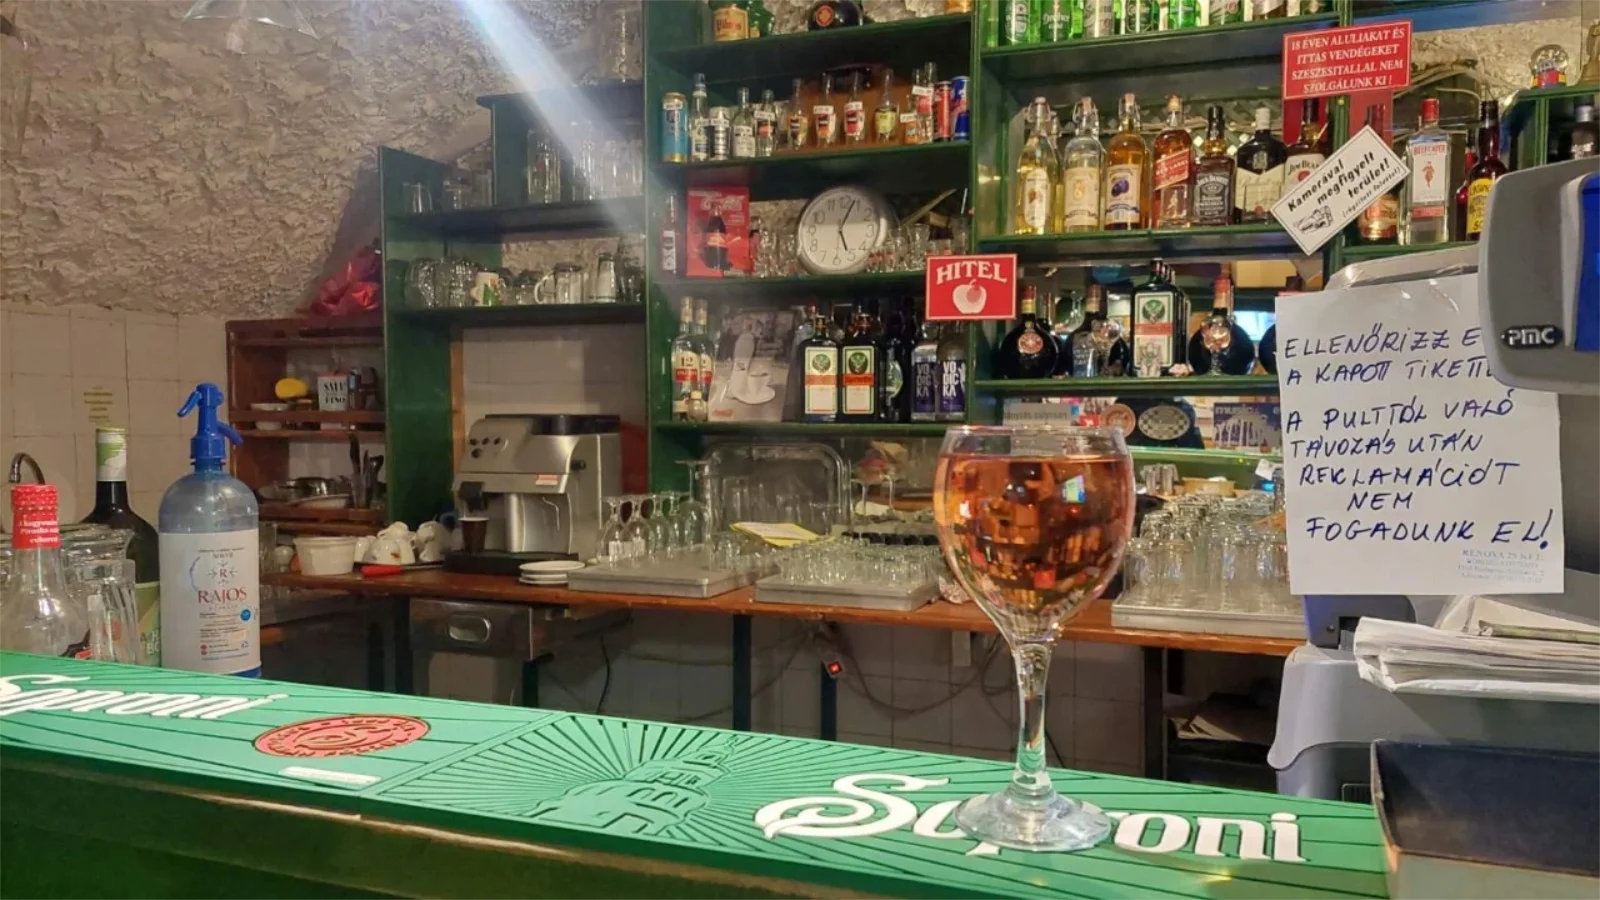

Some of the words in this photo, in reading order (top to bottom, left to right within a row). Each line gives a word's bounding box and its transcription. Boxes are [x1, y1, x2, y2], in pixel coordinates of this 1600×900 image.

[1291, 40, 1301, 51] 18
[1302, 36, 1329, 50] ÉVEN
[1392, 27, 1405, 39] ÉS
[1297, 51, 1327, 65] ITTAS
[1329, 43, 1400, 60] VENDÉGEKET
[1379, 59, 1404, 71] NEM
[1303, 77, 1373, 94] SZOLGÁLUNK
[1286, 158, 1345, 212] Kamerával
[1317, 151, 1375, 205] megfigyelt
[1347, 157, 1390, 198] terület!
[936, 260, 1008, 286] HITEL
[1286, 367, 1302, 386] A
[1315, 359, 1394, 385] KAPOTT
[1286, 410, 1303, 432] A
[1445, 388, 1515, 419] VALÓ
[1290, 428, 1397, 459] TÁVOZÁS
[1408, 428, 1484, 455] UTÁN
[1300, 458, 1520, 488] REKLAMÁCIÓT
[1347, 491, 1414, 512] NEM
[1306, 516, 1475, 542] FOGADUNK
[1491, 508, 1553, 550] EL!
[198, 586, 248, 605] RAJOS
[754, 772, 1307, 863] Sooni
